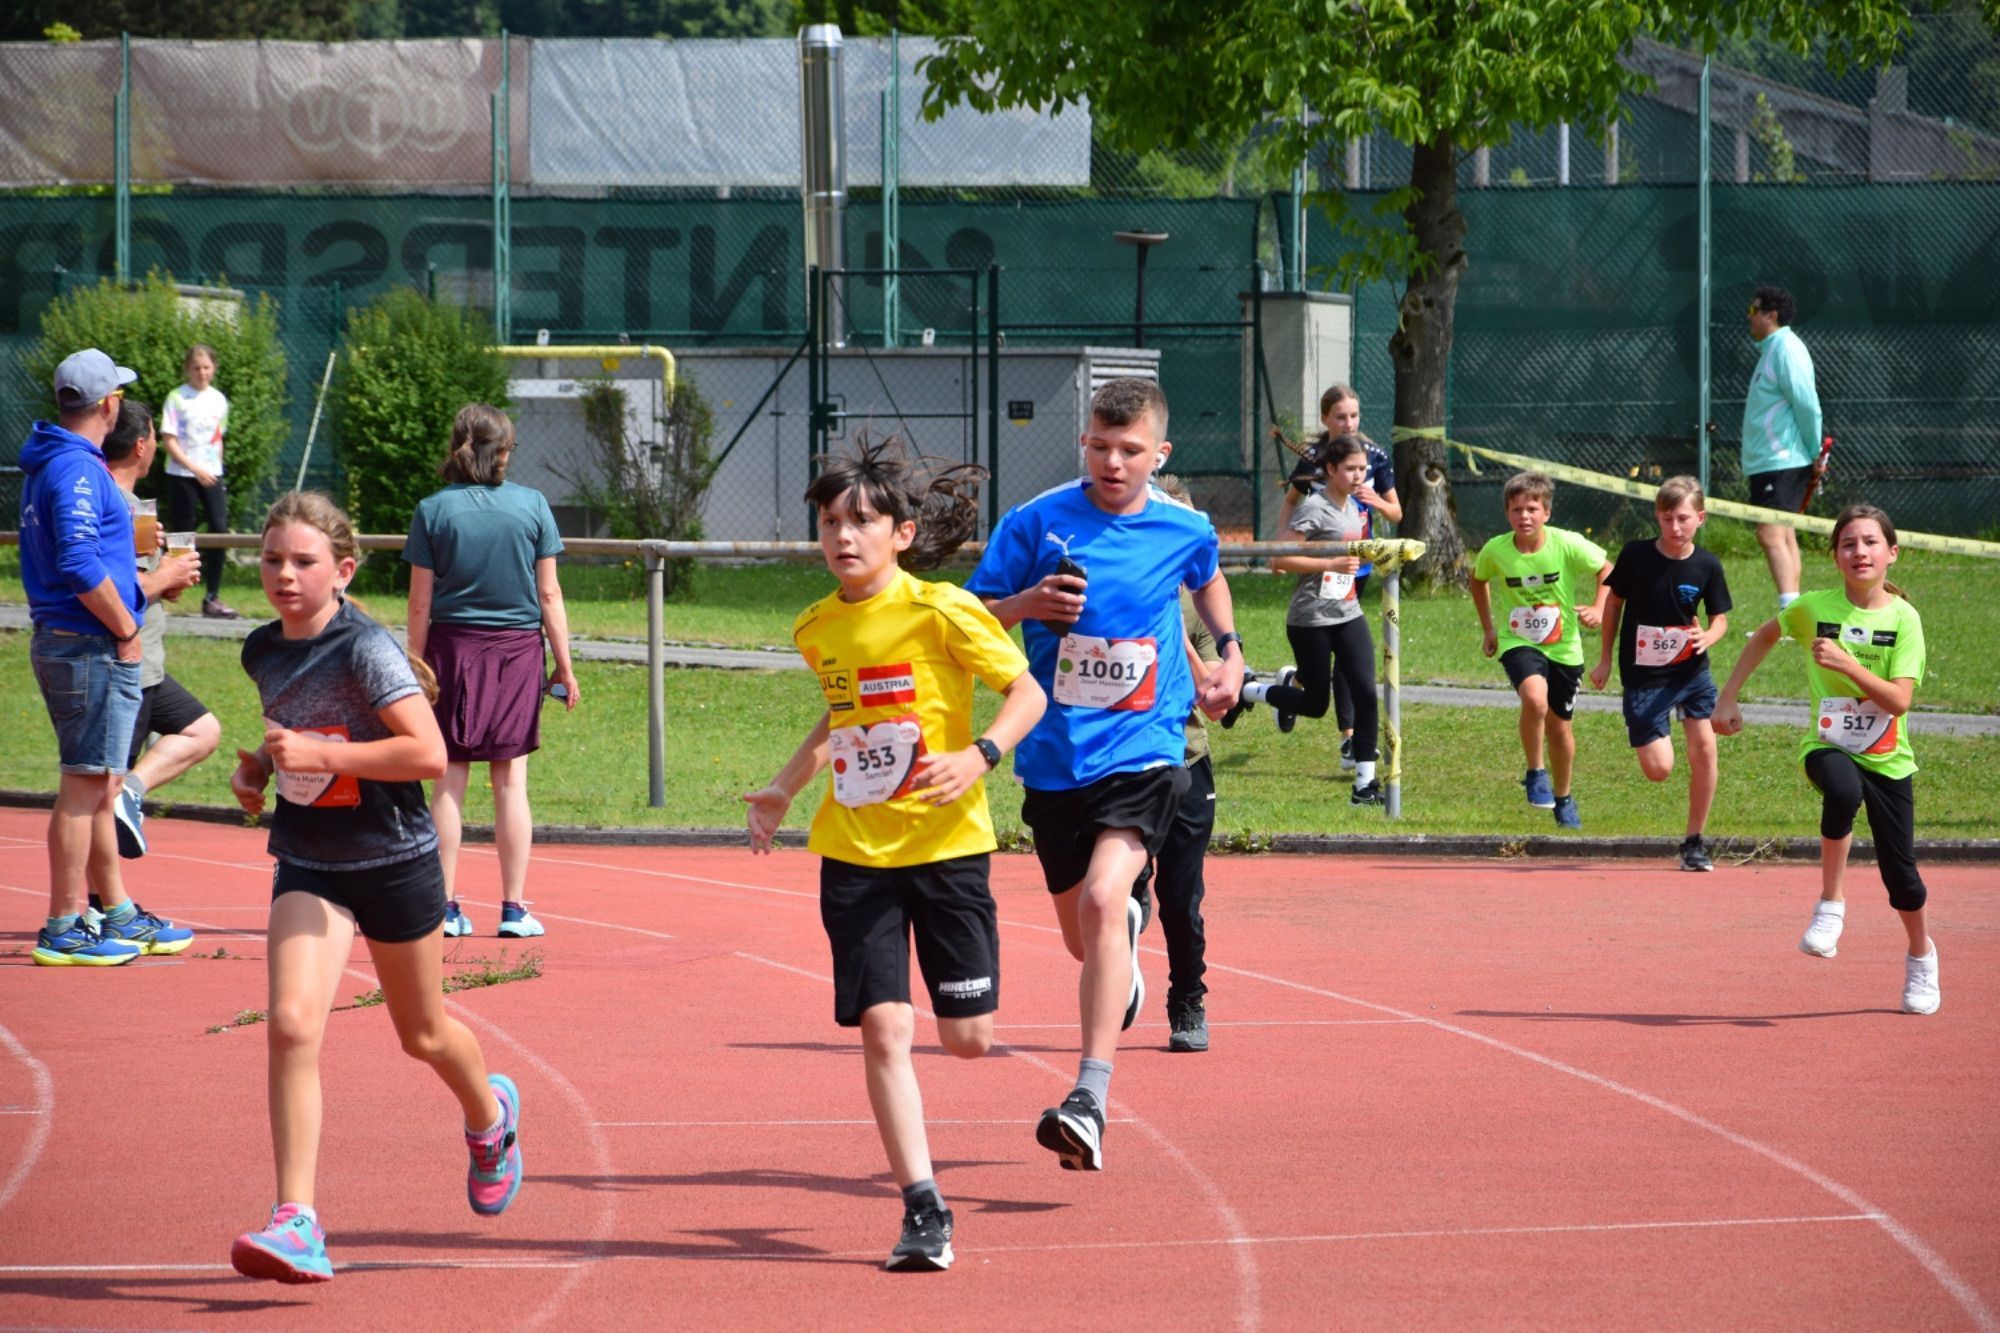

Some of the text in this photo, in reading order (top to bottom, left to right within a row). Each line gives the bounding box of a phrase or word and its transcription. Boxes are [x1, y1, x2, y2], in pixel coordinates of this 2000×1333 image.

[1525, 618, 1548, 629] 509
[1652, 639, 1677, 650] 562
[1078, 659, 1137, 680] 1001
[861, 678, 911, 692] AUSTRIA
[1843, 715, 1877, 730] 517
[857, 745, 897, 771] 553
